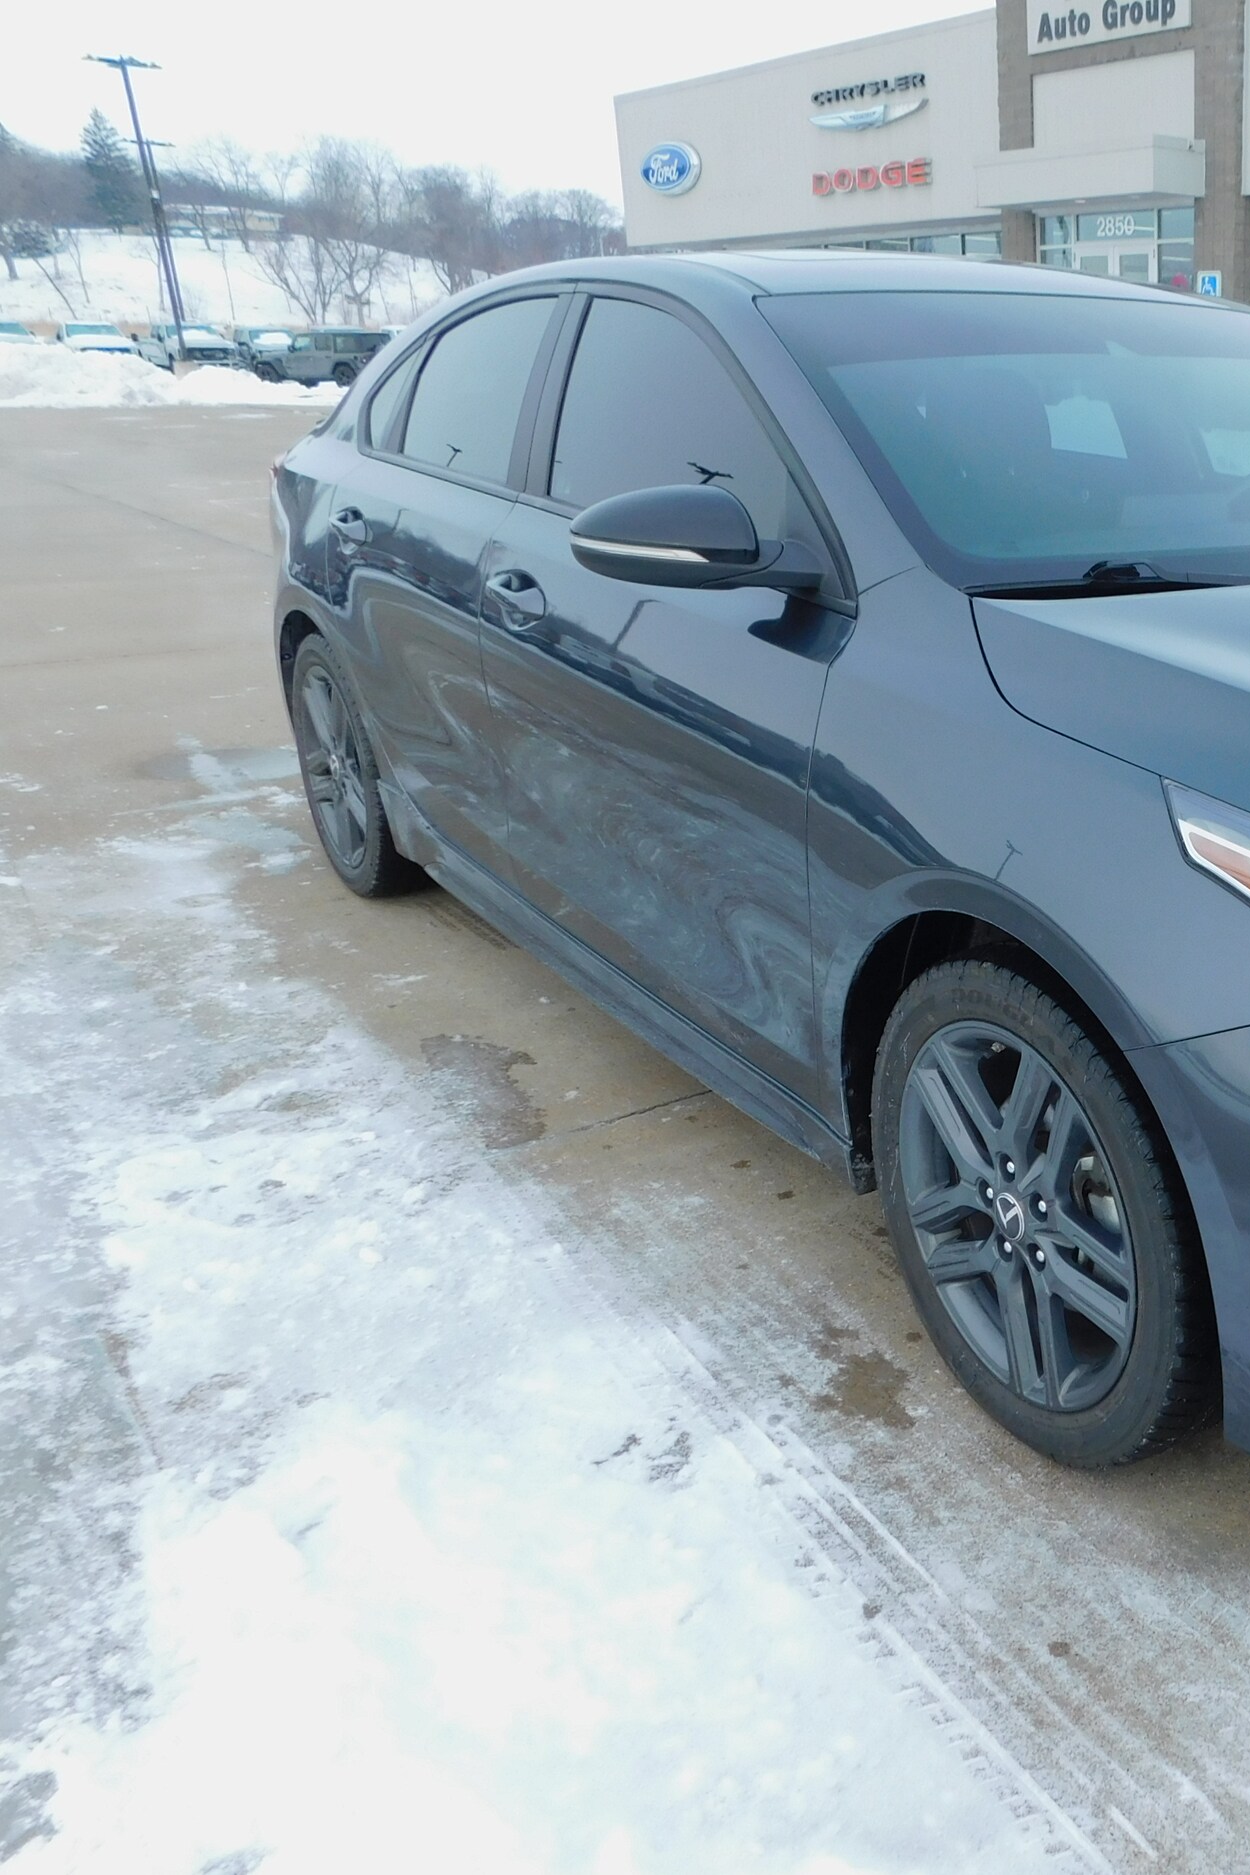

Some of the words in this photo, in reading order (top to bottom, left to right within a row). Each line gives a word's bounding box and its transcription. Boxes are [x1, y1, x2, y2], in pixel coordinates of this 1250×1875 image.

[1037, 9, 1091, 43] Auto
[1102, 0, 1176, 30] Group
[811, 73, 926, 106] CHRYSLER
[649, 153, 679, 185] Ford
[812, 157, 931, 195] DODGE
[1097, 215, 1135, 237] 2850
